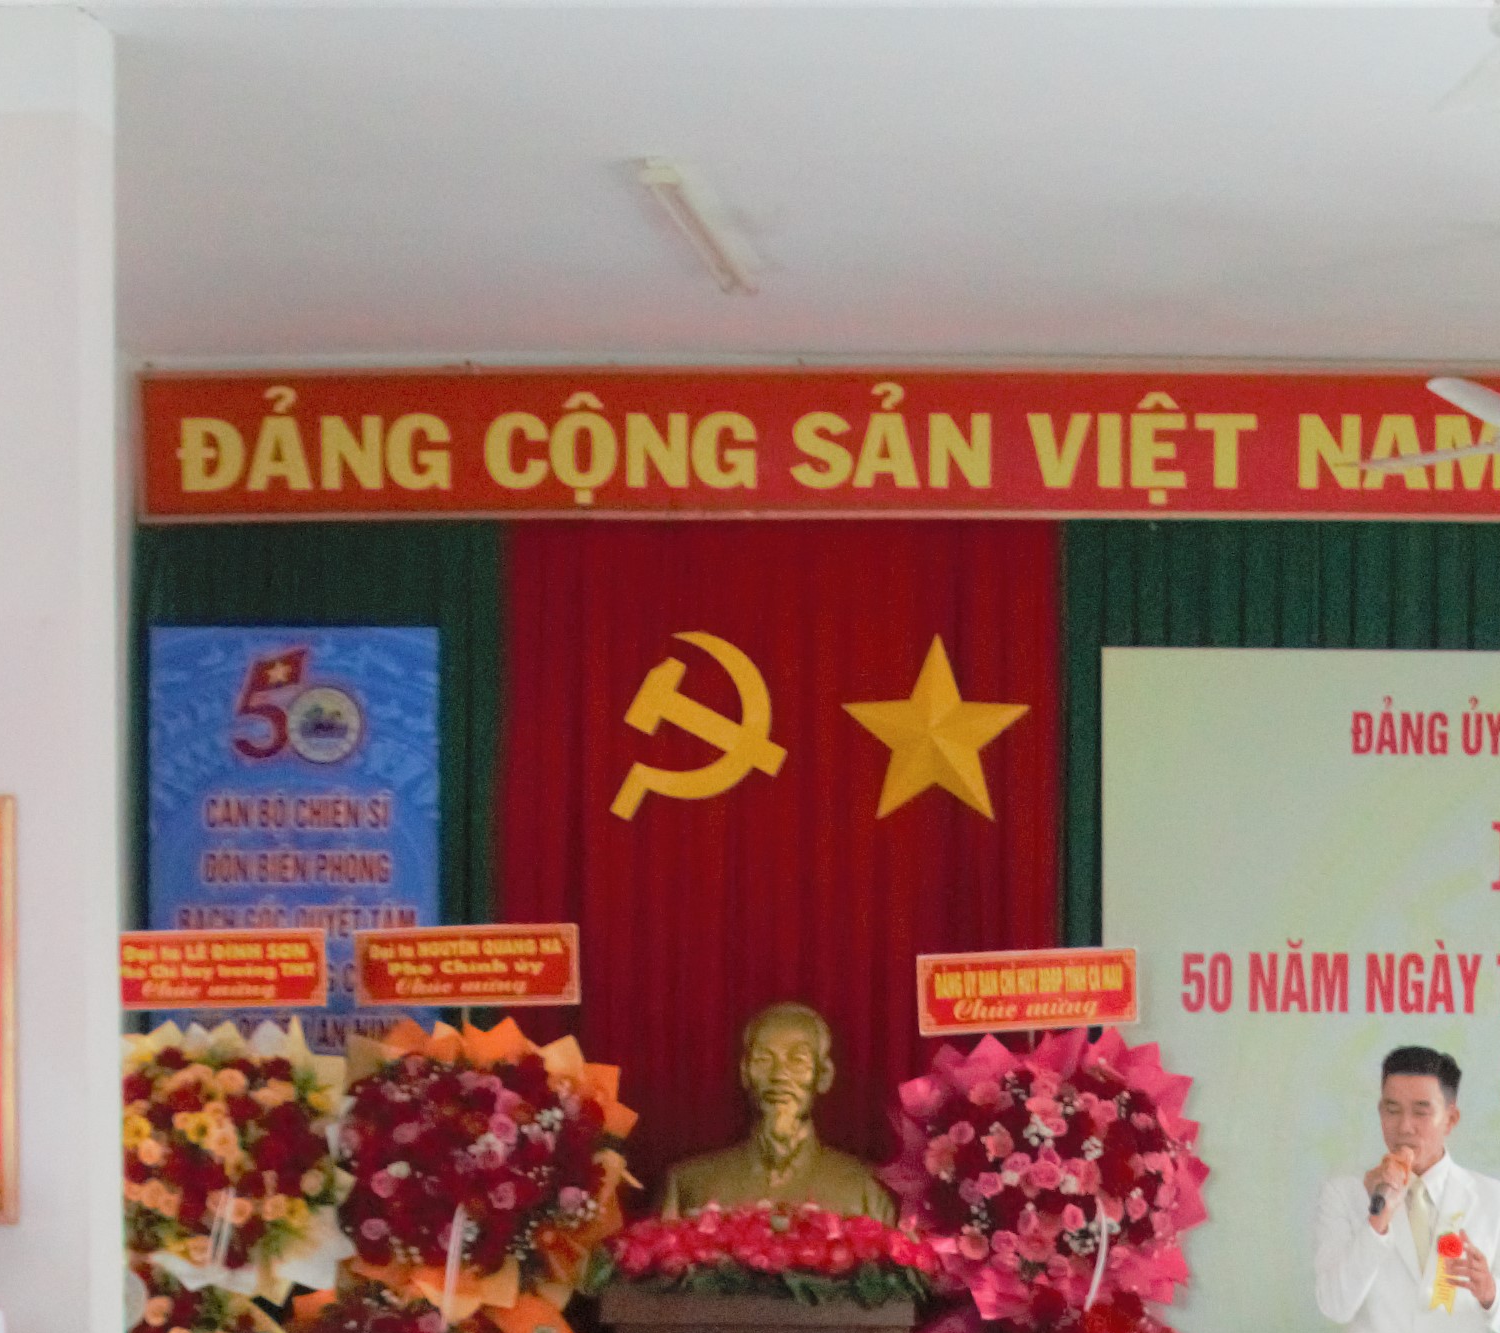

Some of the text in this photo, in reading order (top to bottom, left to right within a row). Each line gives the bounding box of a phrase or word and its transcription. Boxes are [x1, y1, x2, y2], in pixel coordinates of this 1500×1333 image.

[177, 384, 451, 492] ĐẢNG
[483, 391, 758, 504] CỘNG
[789, 381, 994, 490] SẢN
[1026, 391, 1258, 506] VIỆT
[1350, 696, 1449, 756] ĐẢNG
[953, 998, 1099, 1021] Chúc mừng
[1181, 952, 1232, 1014] 50
[1247, 938, 1350, 1013] NĂM
[1365, 940, 1482, 1014] NGÀY
